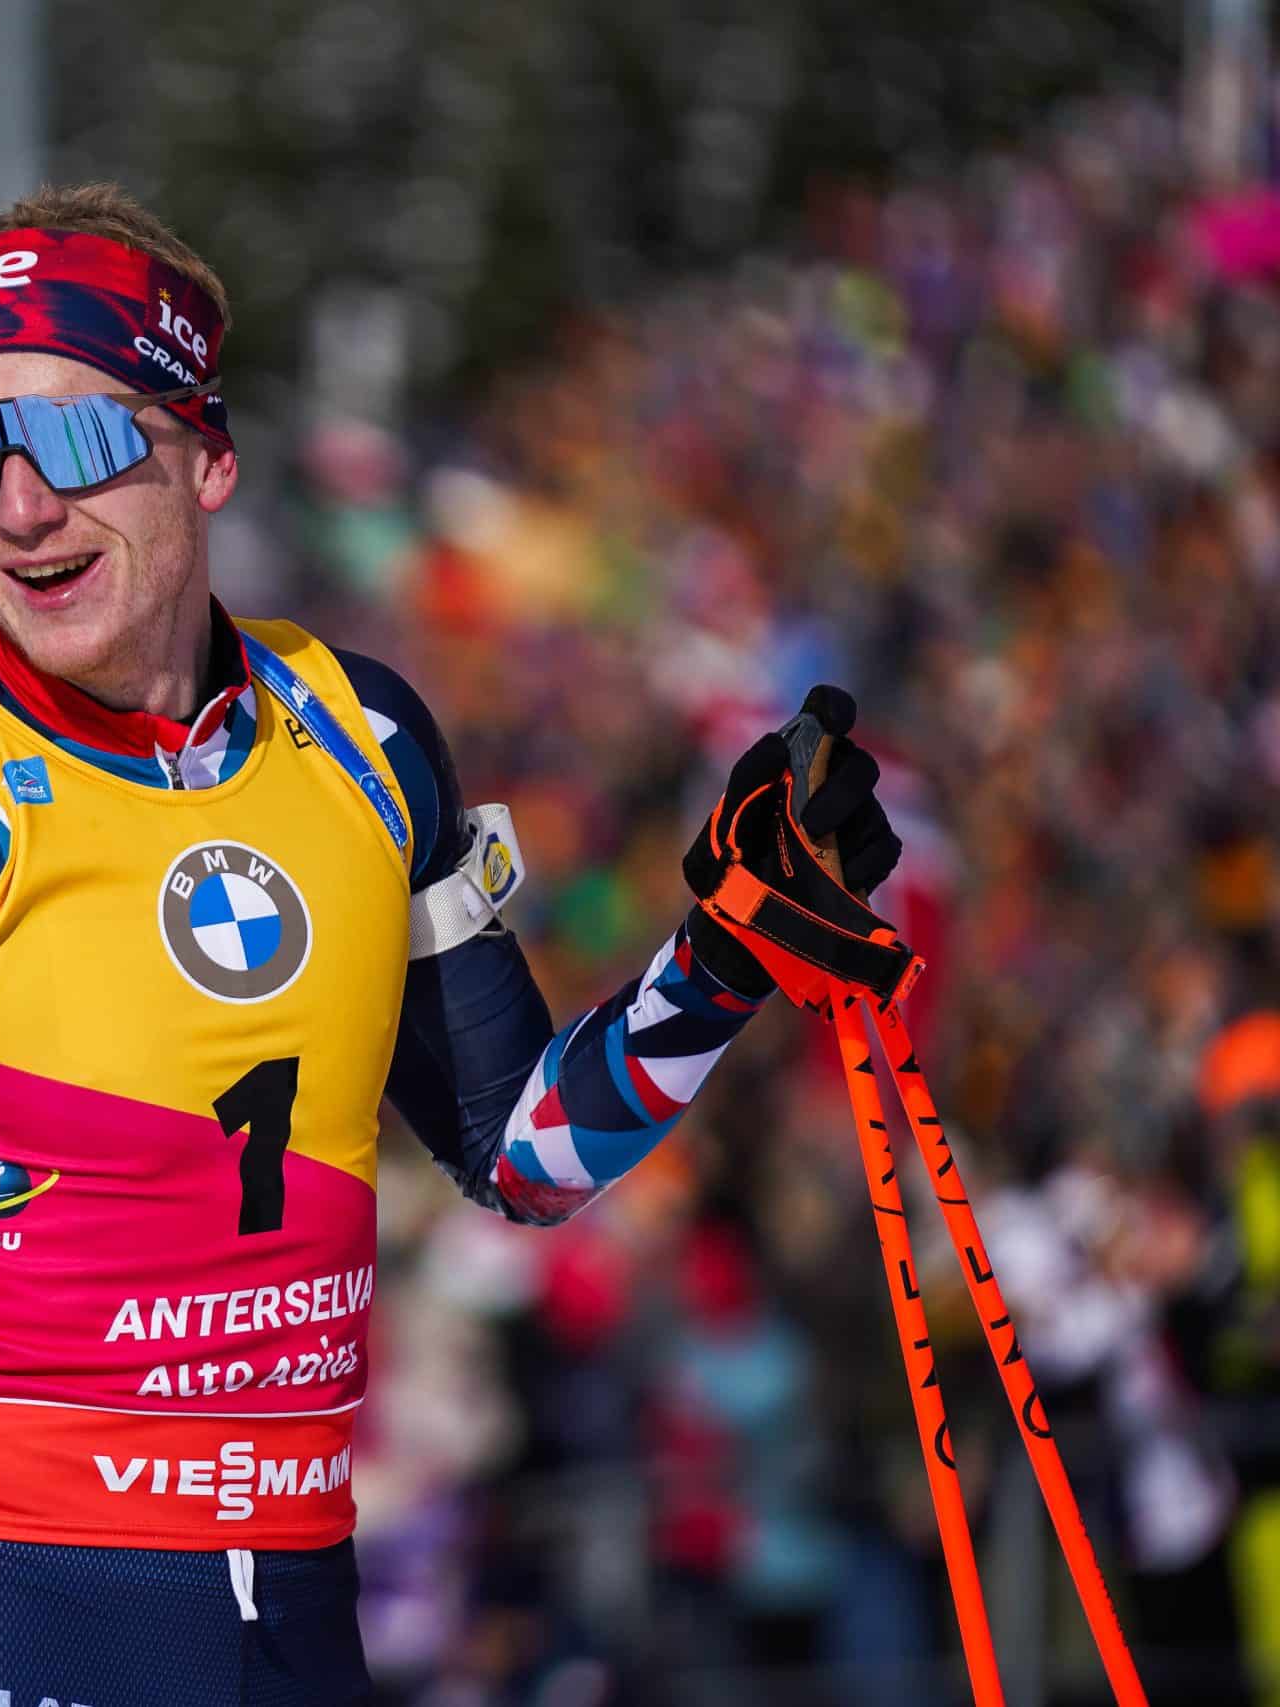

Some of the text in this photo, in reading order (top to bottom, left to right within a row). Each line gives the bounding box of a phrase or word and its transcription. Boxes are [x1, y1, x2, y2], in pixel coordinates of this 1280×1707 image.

[134, 336, 200, 387] CRAF
[170, 848, 275, 900] BMW
[212, 1056, 300, 1235] 1
[104, 1264, 374, 1343] ANTERSELVA
[93, 1441, 350, 1520] VIESSMANN
